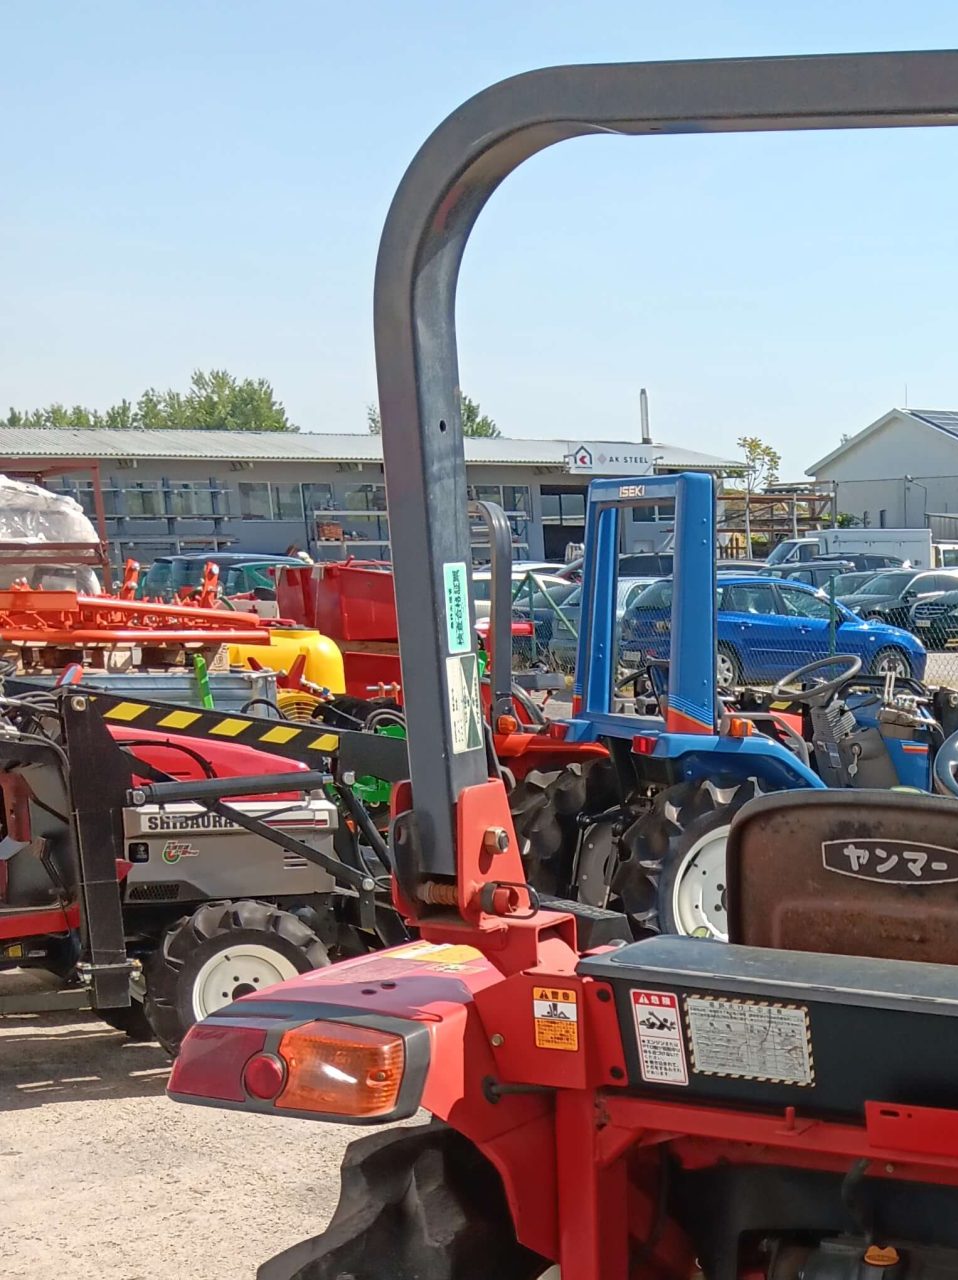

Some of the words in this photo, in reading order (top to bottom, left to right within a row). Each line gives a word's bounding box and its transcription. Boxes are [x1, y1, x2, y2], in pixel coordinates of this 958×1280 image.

[623, 456, 649, 464] STEEL
[619, 485, 645, 497] ISEKI
[148, 815, 232, 831] SHIBAURA
[843, 844, 948, 877] ヤンマー
